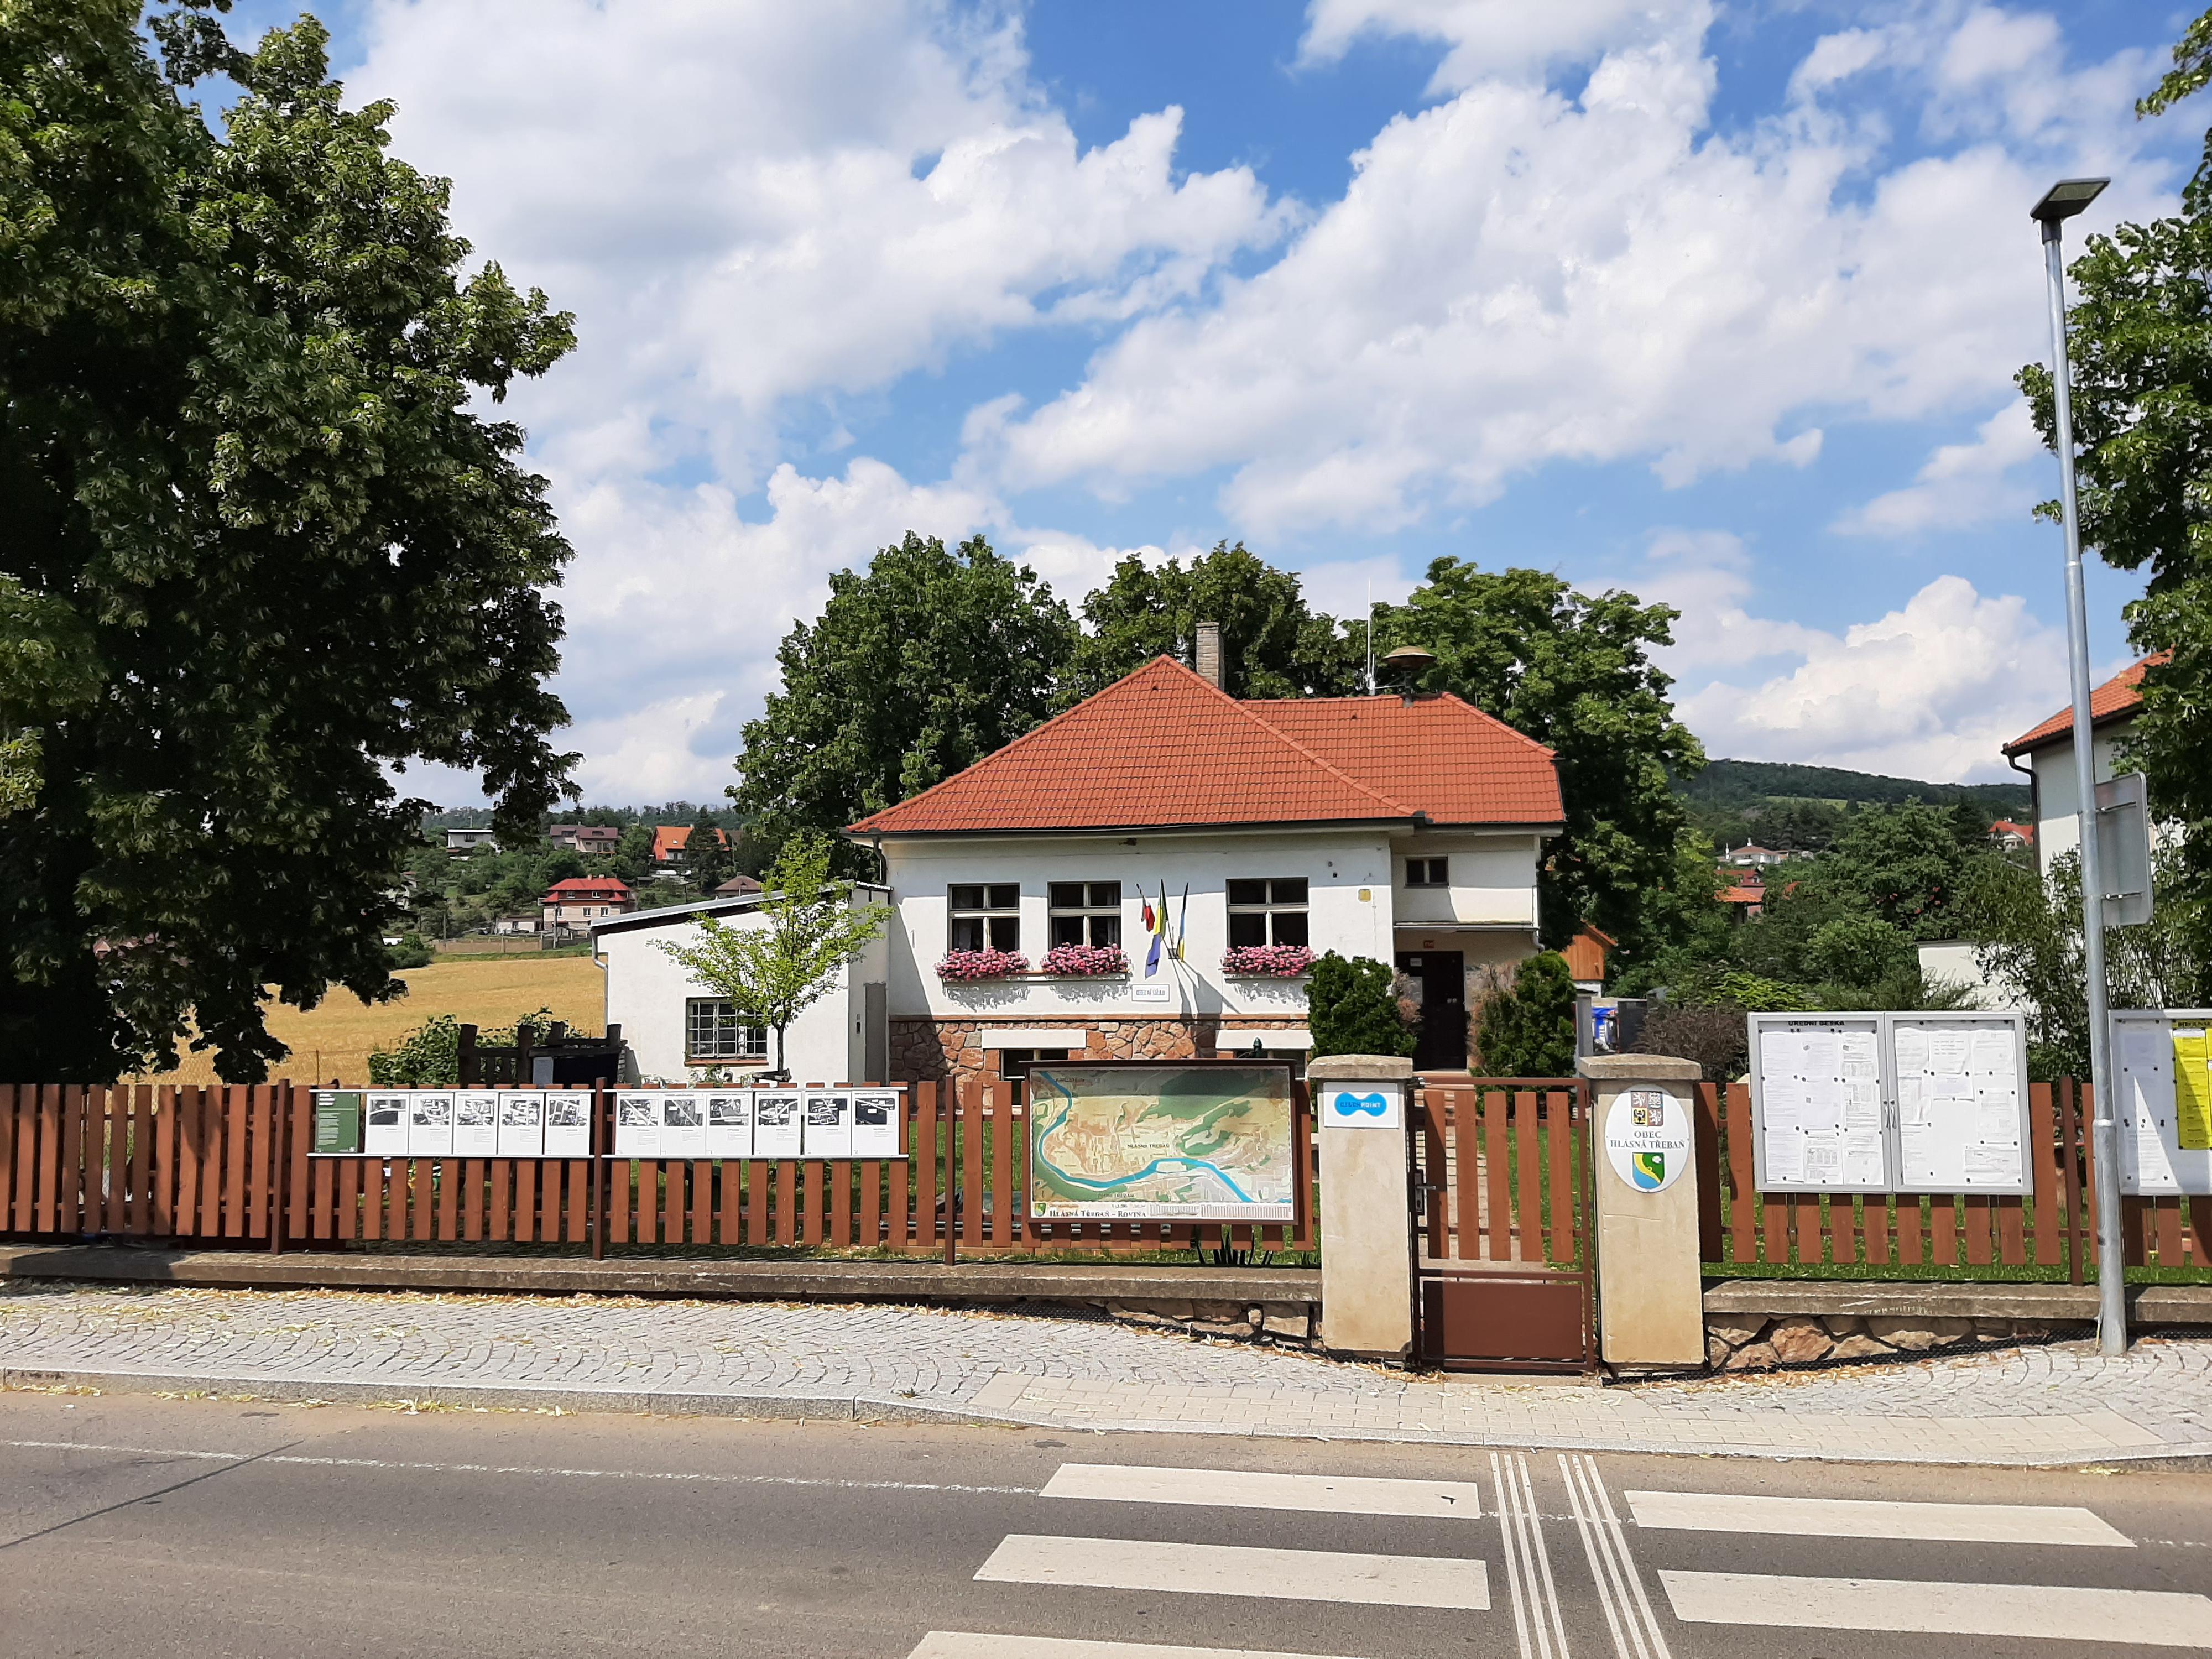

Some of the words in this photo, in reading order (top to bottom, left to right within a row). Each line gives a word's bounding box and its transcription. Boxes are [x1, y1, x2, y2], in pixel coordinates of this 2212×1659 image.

[1634, 1130, 1662, 1139] OBEC
[1610, 1139, 1647, 1149] HLÁSNÁ
[1649, 1139, 1685, 1149] TŘEBAŇ
